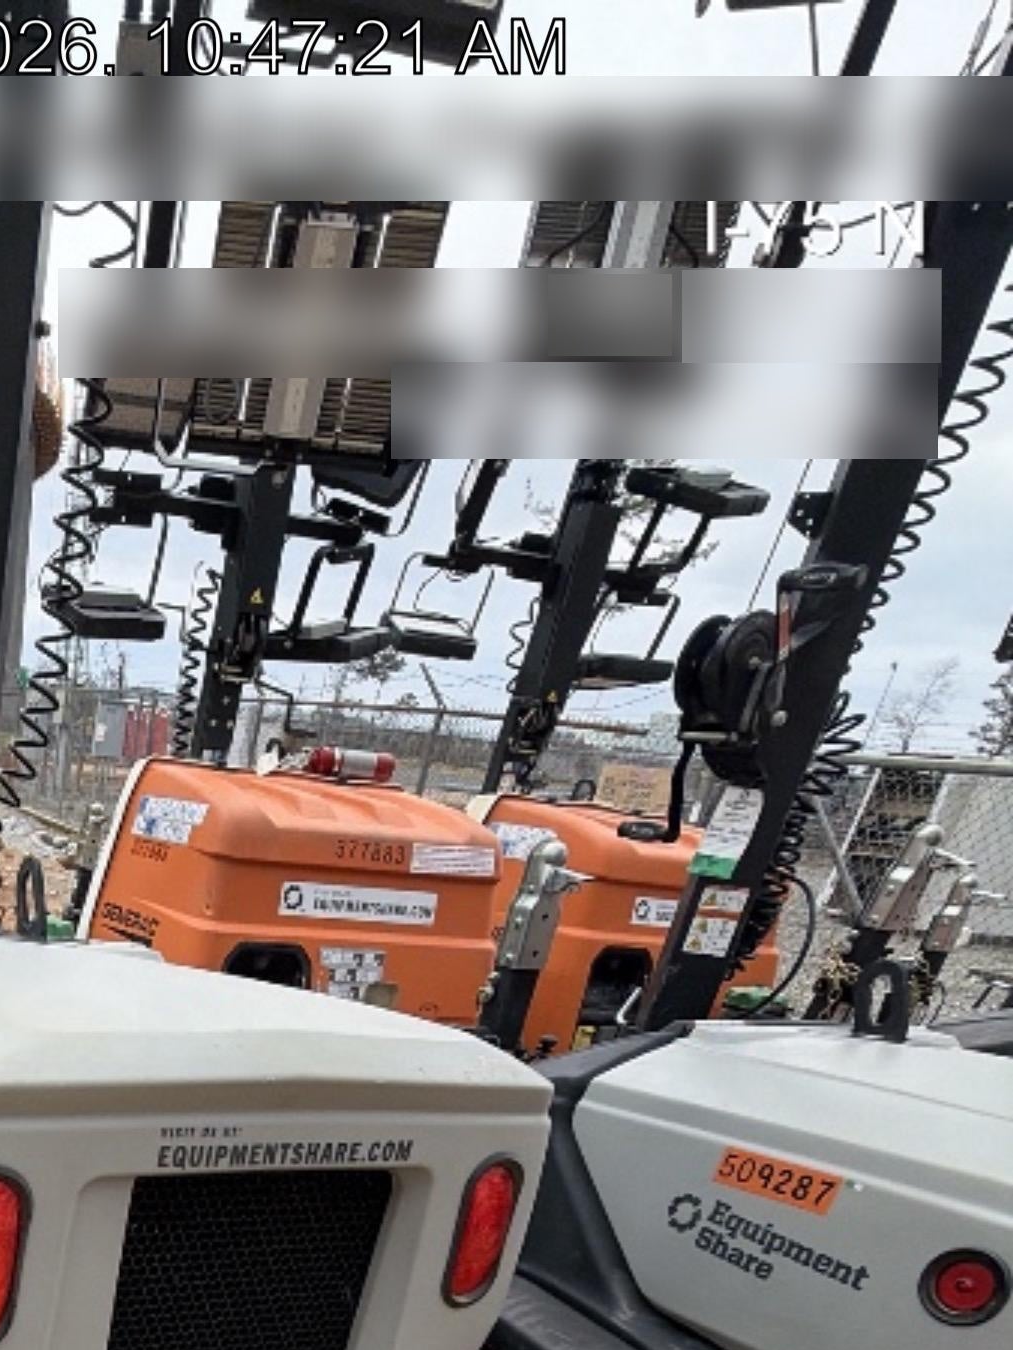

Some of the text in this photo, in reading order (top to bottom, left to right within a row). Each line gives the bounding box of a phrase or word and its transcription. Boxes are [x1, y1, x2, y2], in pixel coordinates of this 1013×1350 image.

[156, 1139, 414, 1169] EQUIPMENTSHARE.COM
[717, 1153, 837, 1207] 509287
[695, 1226, 774, 1280] Share
[707, 1199, 870, 1291] Equipment
